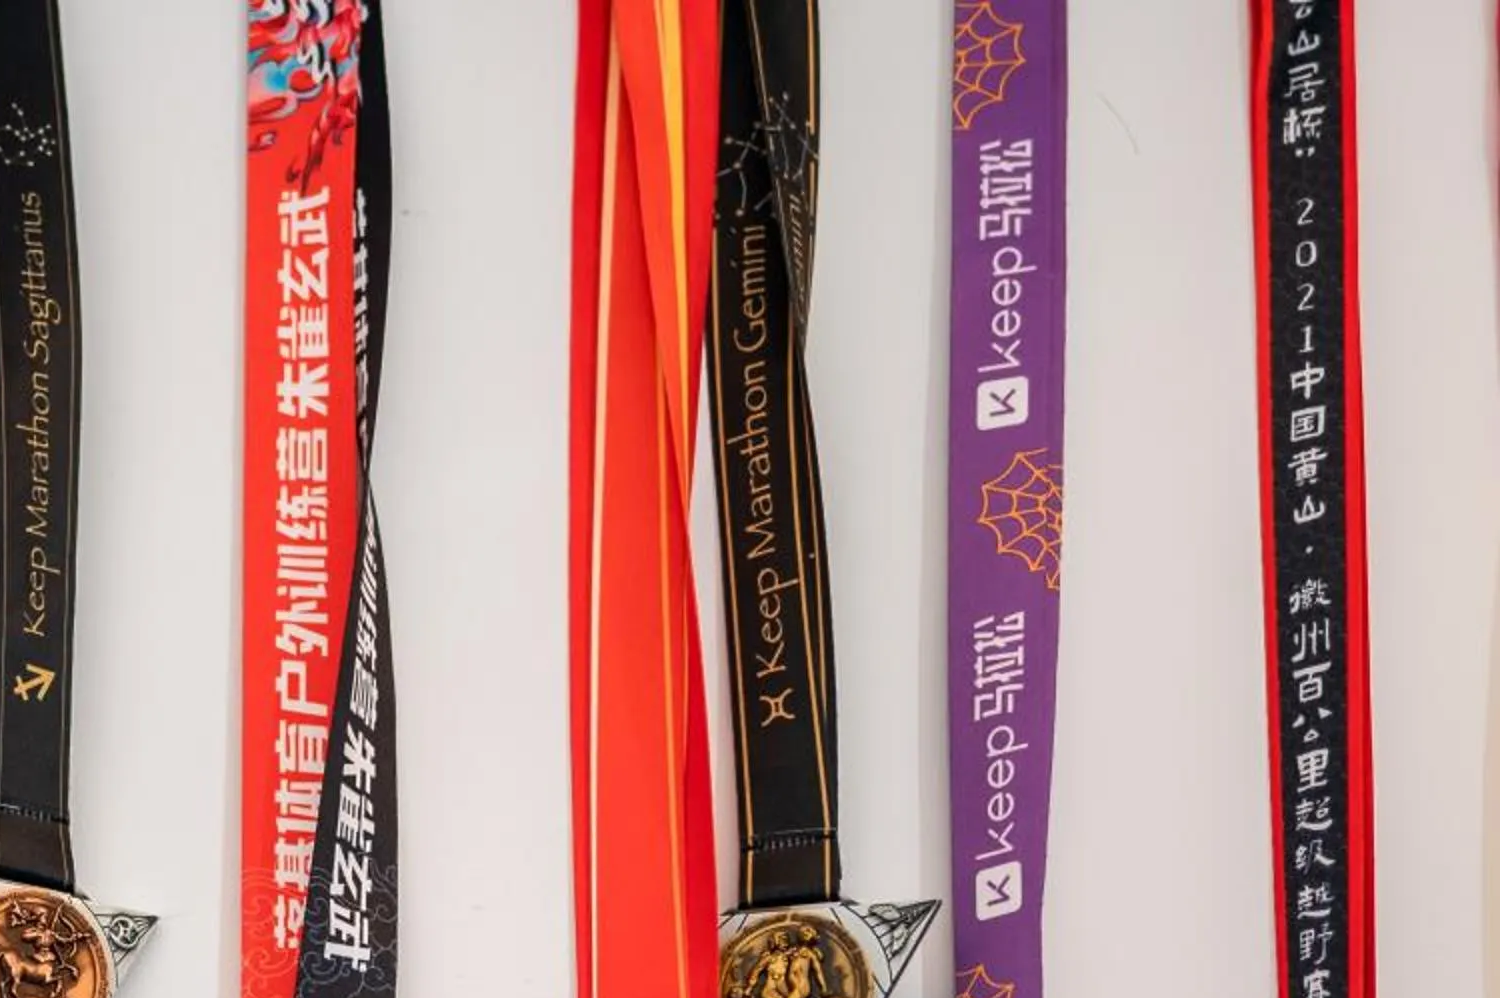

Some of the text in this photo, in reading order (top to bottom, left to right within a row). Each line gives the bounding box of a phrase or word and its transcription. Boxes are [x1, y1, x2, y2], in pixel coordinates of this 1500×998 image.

[15, 190, 62, 638] Keep Marathon Sagittarius
[726, 225, 800, 677] Keep Marathon Gemini
